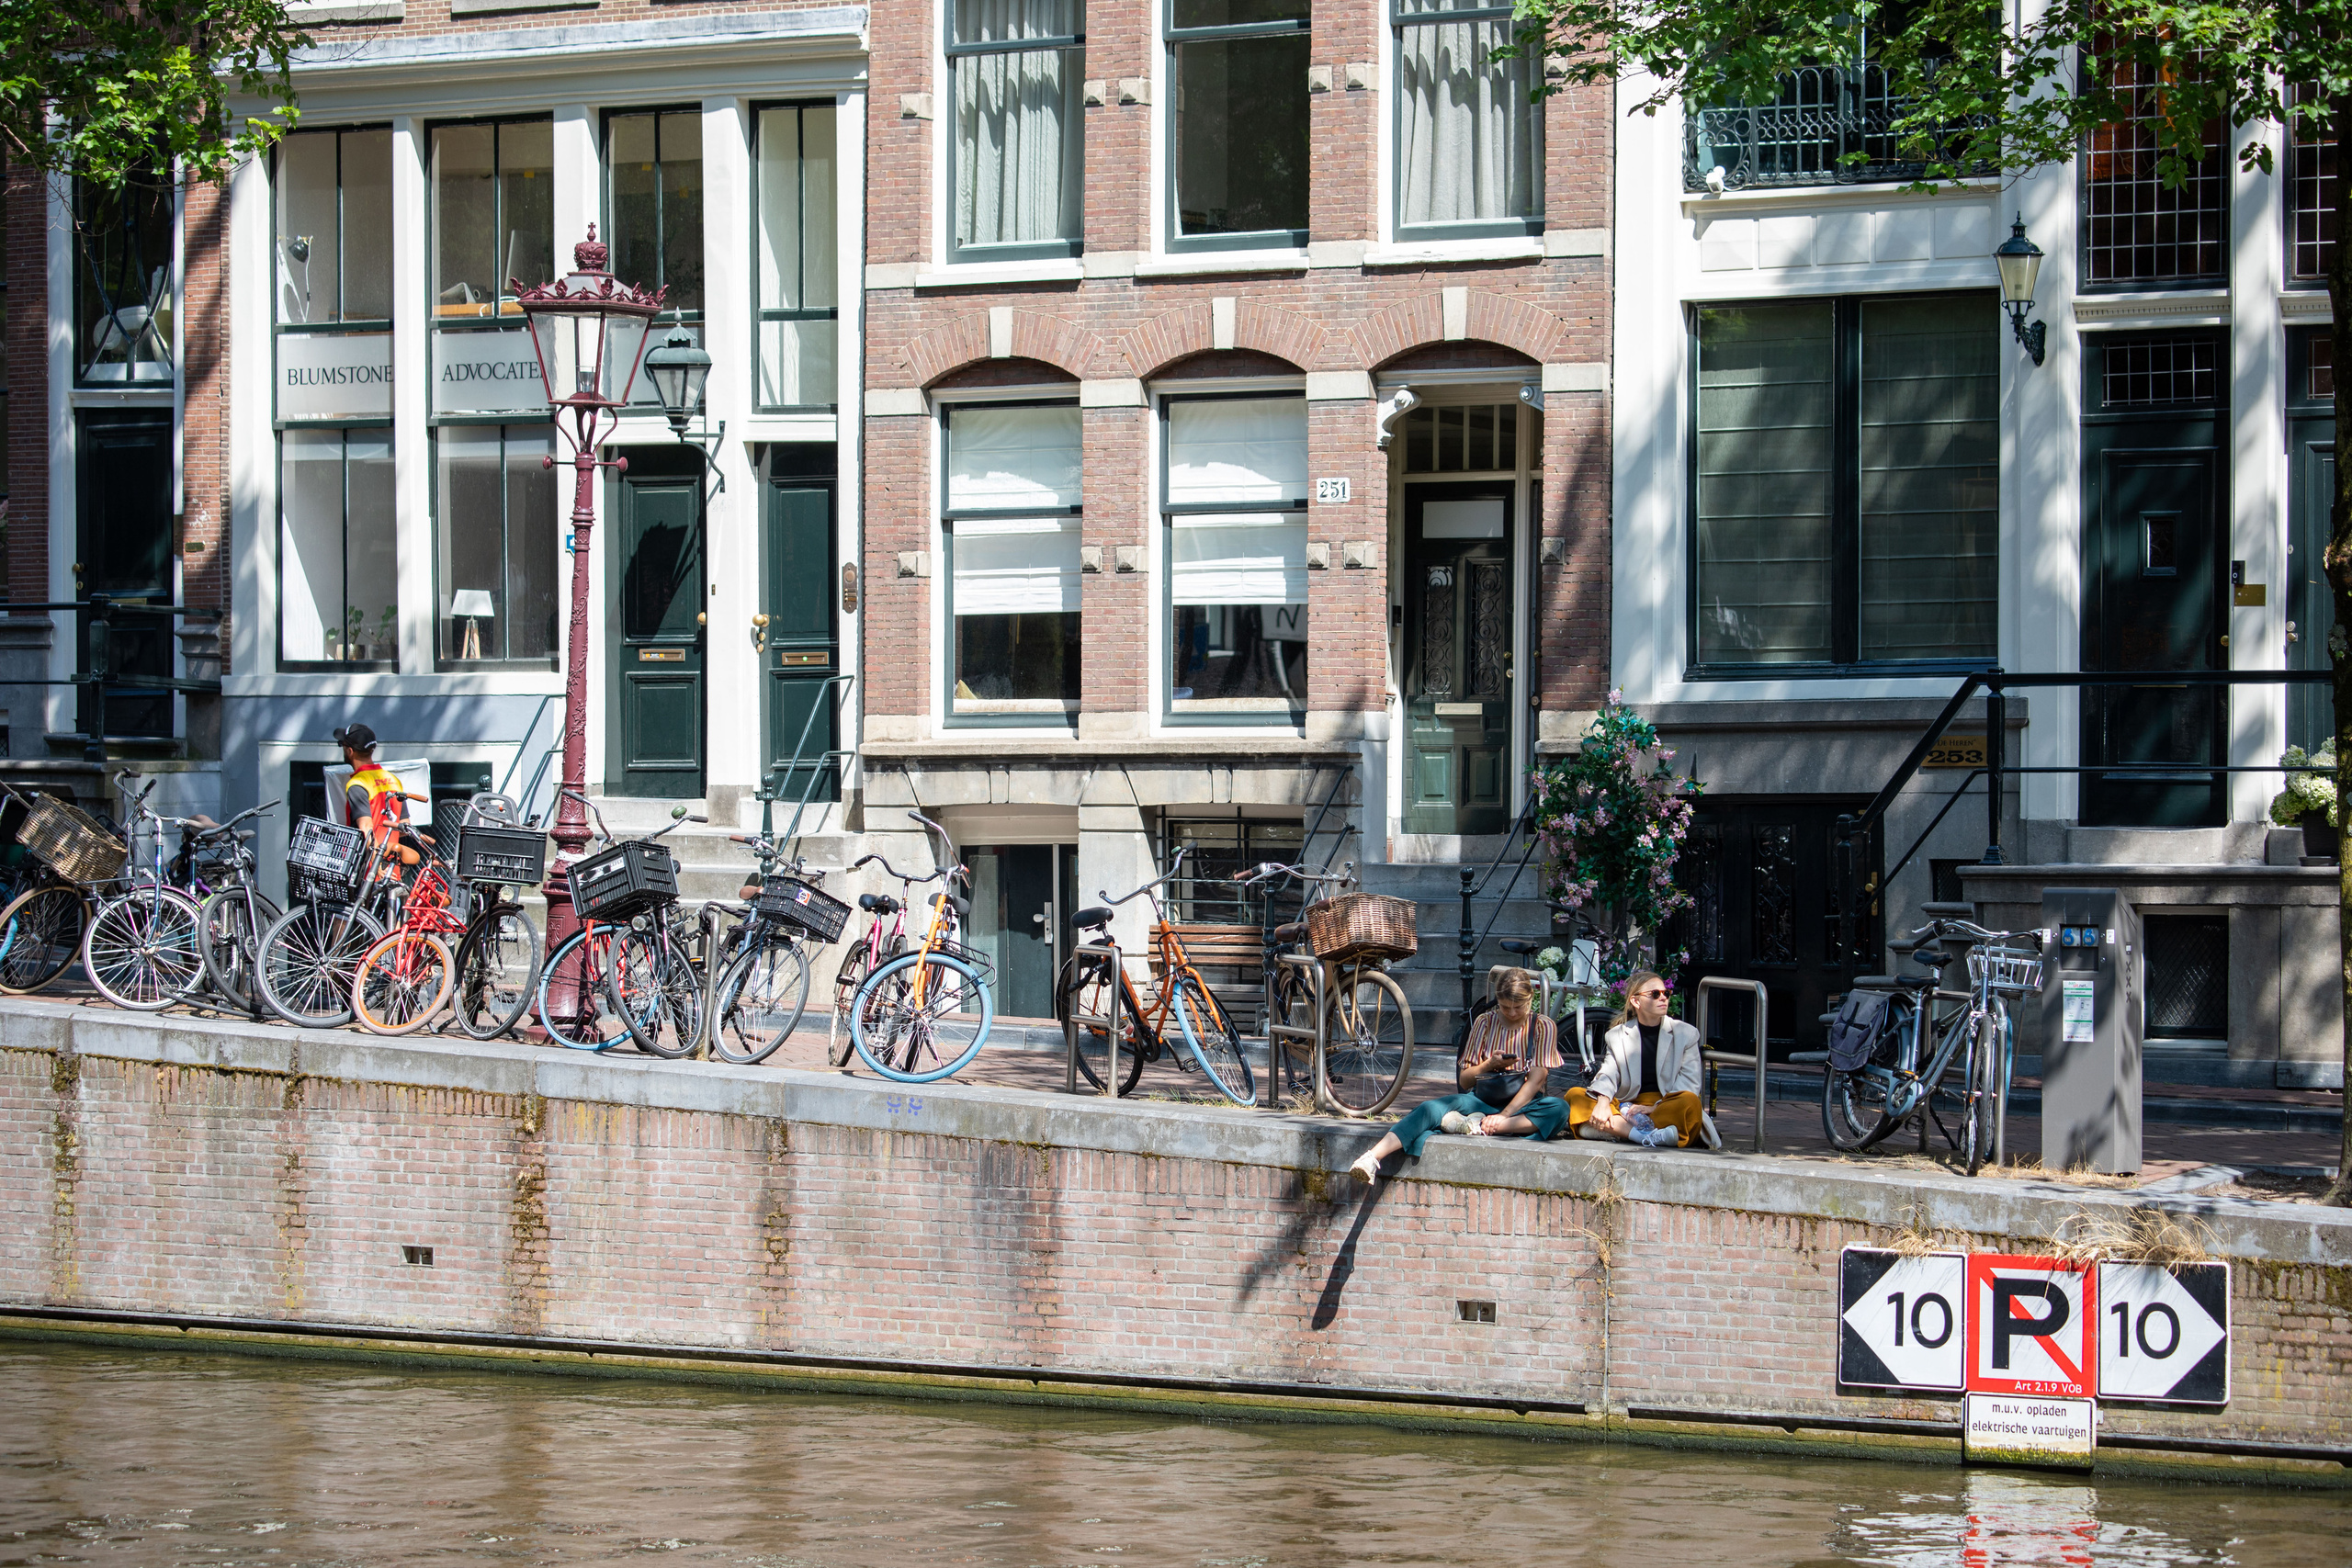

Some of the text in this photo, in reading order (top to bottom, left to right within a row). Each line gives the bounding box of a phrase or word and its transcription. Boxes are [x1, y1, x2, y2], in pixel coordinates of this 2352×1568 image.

[288, 361, 543, 387] BLUMSTONE ADVOCATE
[1319, 480, 1347, 499] 251
[1928, 750, 1984, 763] 253
[1886, 1292, 1953, 1349] 10
[1992, 1278, 2070, 1370] P
[2110, 1302, 2181, 1359] 10
[2015, 1381, 2083, 1393] Art 2.1.9 VOB
[1992, 1404, 2067, 1417] m.u.v. opladen
[1972, 1420, 2086, 1439] elektrische vaartuigen
